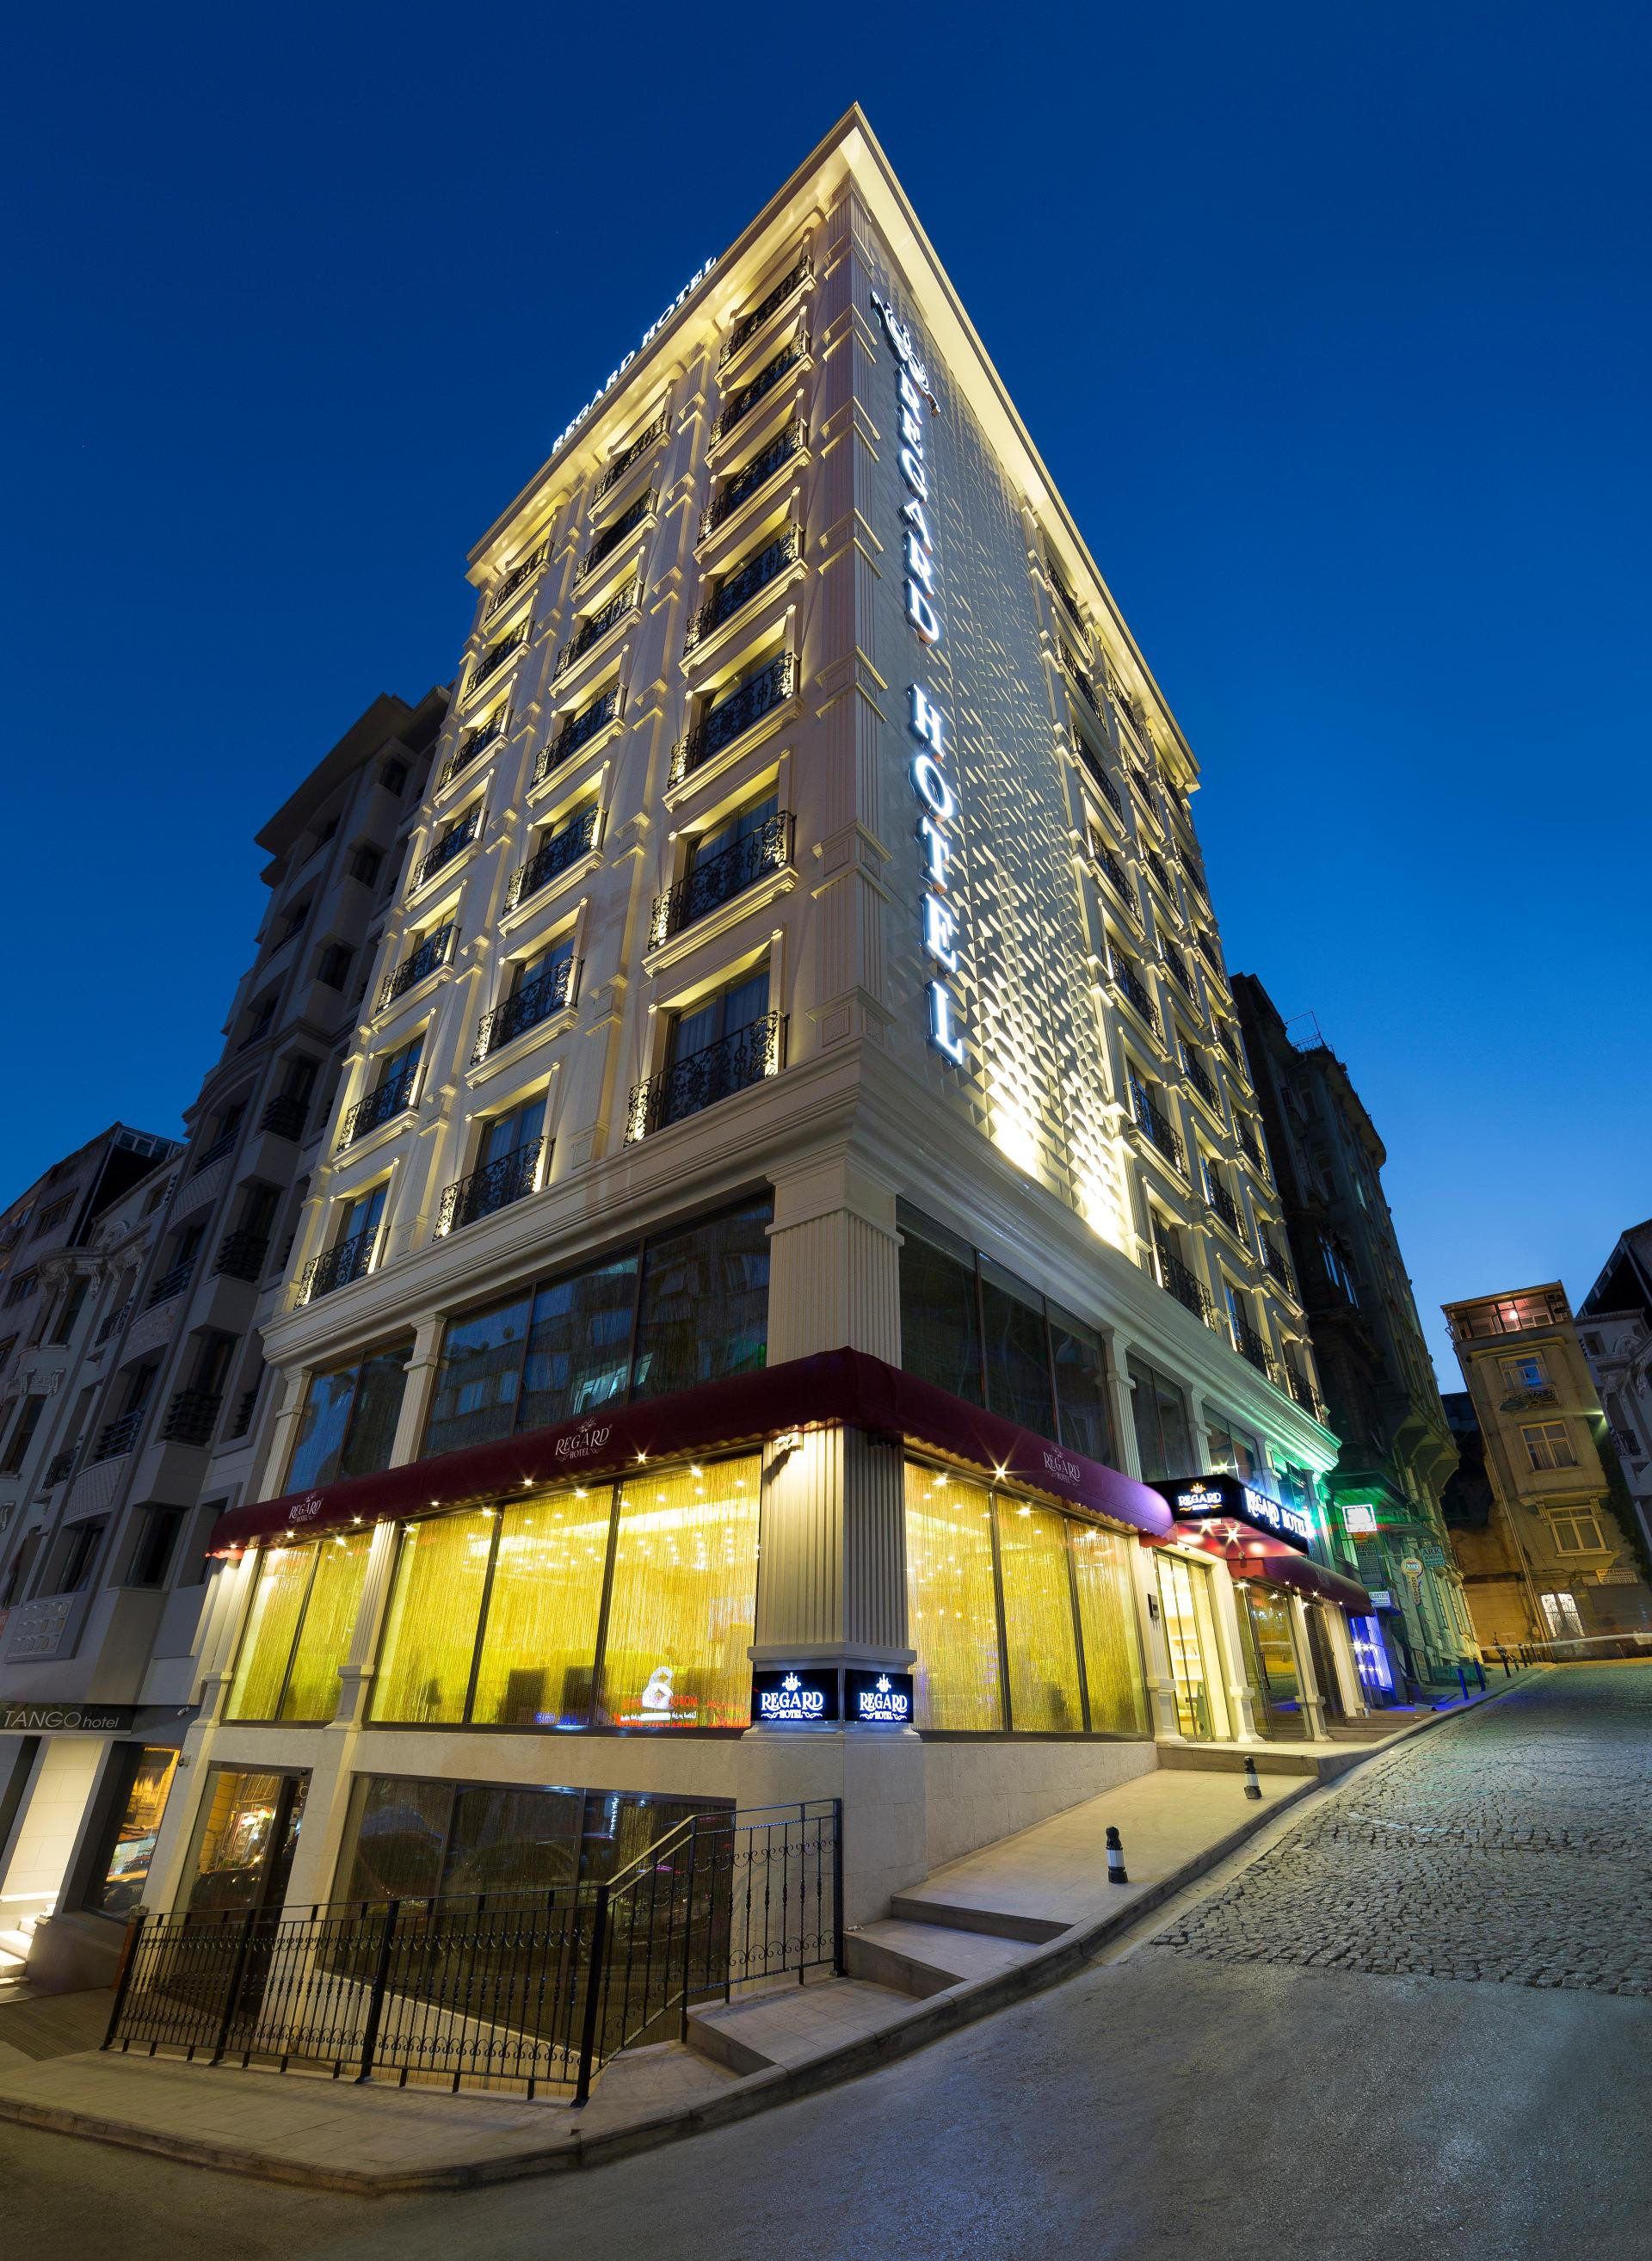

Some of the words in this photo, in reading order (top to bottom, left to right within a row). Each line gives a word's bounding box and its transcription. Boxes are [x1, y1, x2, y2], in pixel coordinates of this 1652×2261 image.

[552, 350, 636, 453] REGARD
[641, 256, 718, 348] HOTEL
[897, 367, 940, 645] REGARD
[907, 682, 964, 1068] HOTEL
[555, 1427, 610, 1456] REGARD
[569, 1447, 590, 1459] HOTEL
[1043, 1451, 1081, 1482] REGARD
[1177, 1492, 1223, 1506] REGARD
[1244, 1487, 1280, 1529] REGARD
[288, 1500, 322, 1519] REGARD
[761, 1691, 823, 1711] REGARD
[859, 1692, 908, 1713] REGARD
[3, 1710, 82, 1728] TANGO
[83, 1716, 120, 1728] hotel
[779, 1710, 804, 1719] HOTEL
[874, 1711, 893, 1720] HOTEL
